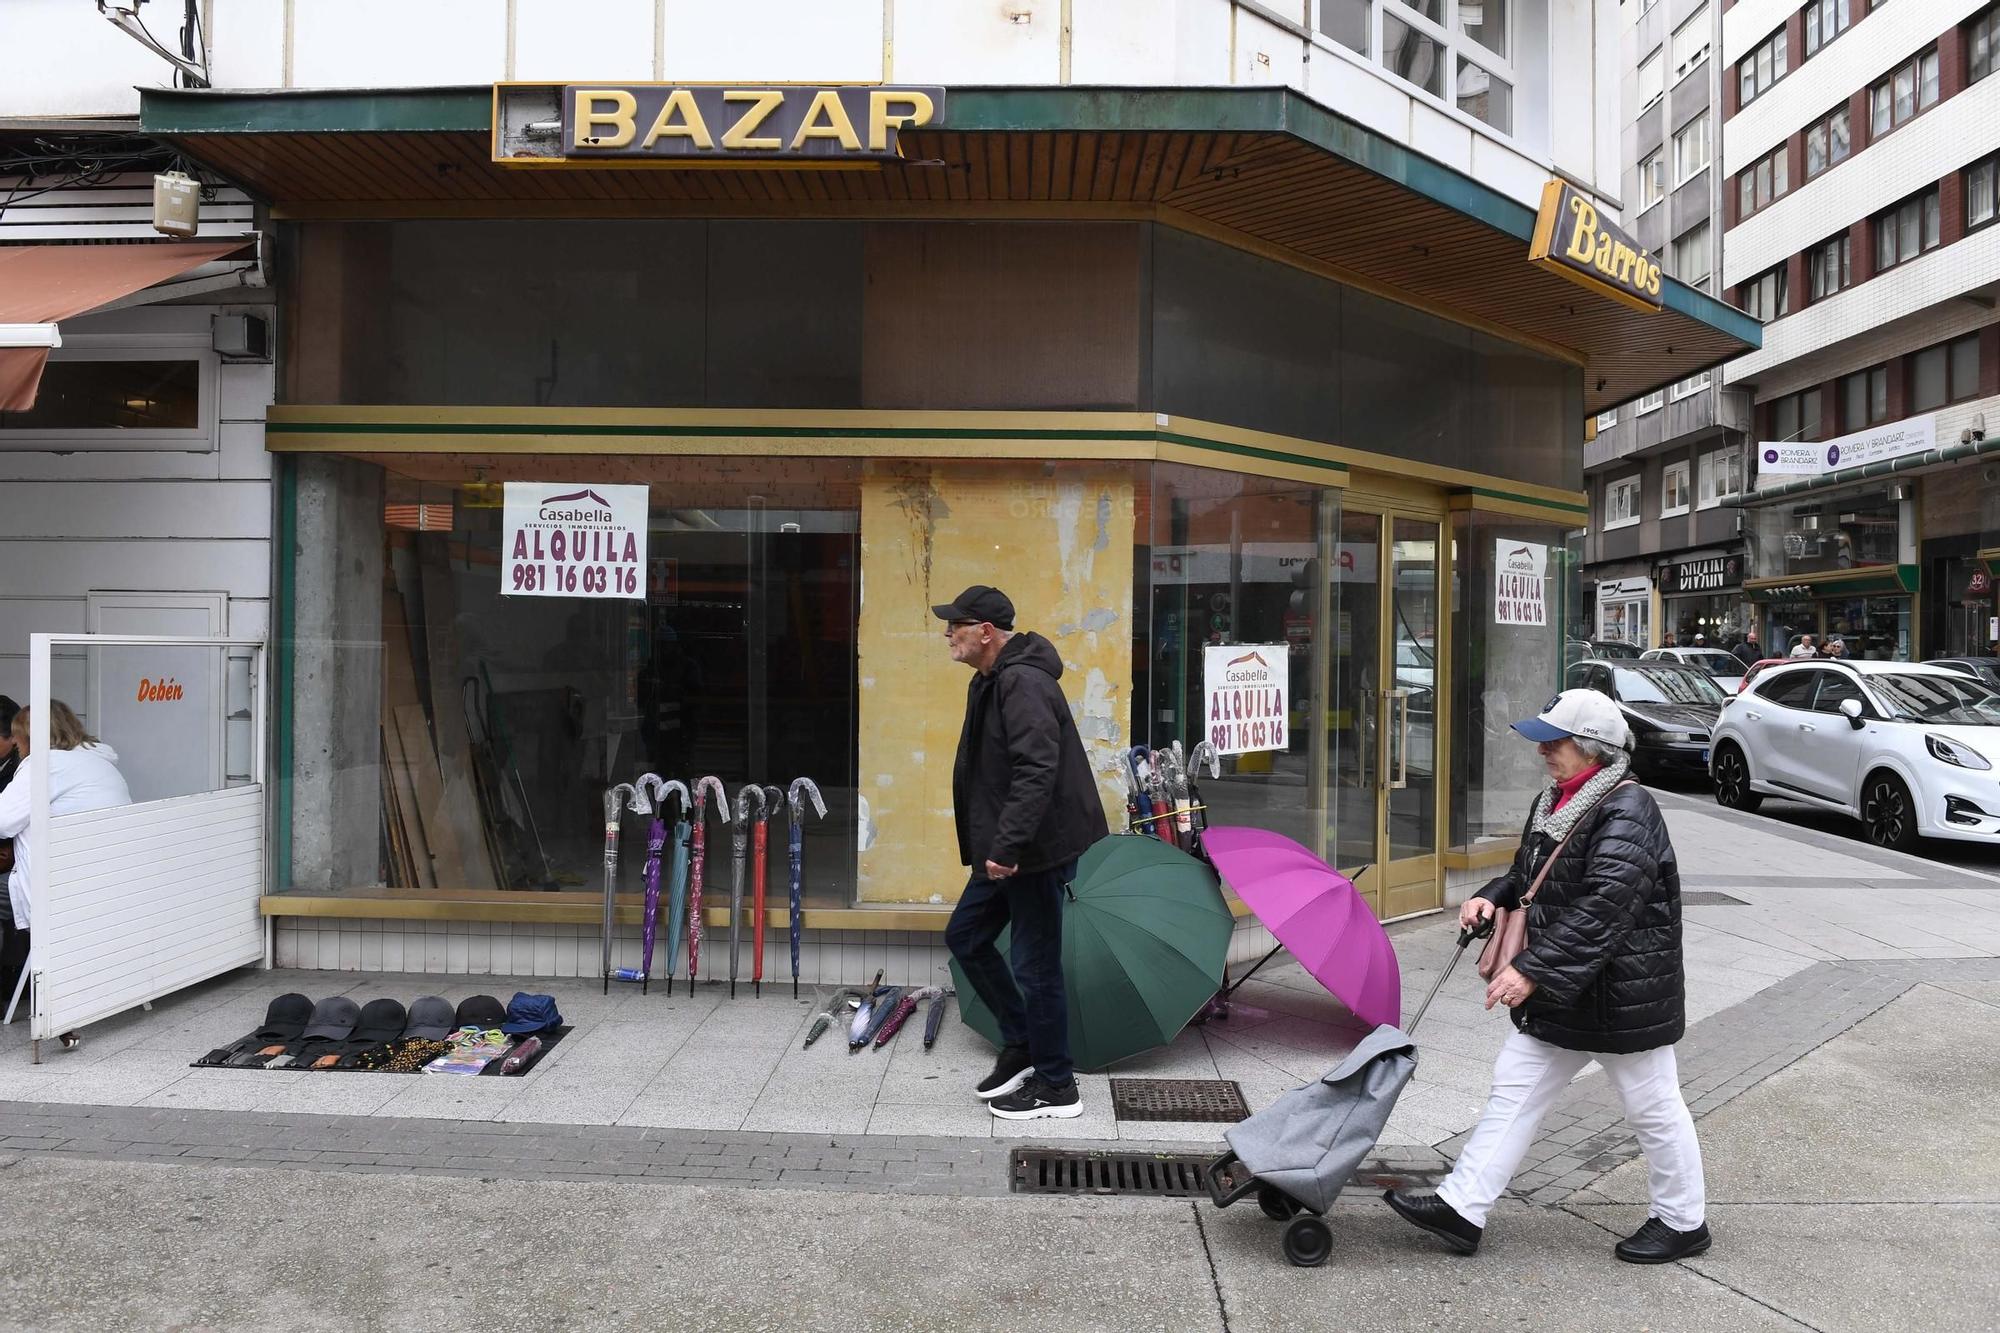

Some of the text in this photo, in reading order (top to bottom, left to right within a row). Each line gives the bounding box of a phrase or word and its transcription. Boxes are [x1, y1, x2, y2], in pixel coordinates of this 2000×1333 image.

[1566, 196, 1661, 296] Barrós
[1840, 442, 1865, 455] ROMERA
[539, 508, 613, 523] Casabella
[512, 529, 638, 563] ALQUILA
[512, 564, 637, 594] 981 16 03 16
[1499, 574, 1541, 600] ALQUILA
[1680, 558, 1724, 591] DIVAIN
[1498, 600, 1511, 621] 981
[1514, 601, 1522, 622] 16
[1534, 603, 1542, 623] 16
[1226, 669, 1268, 682] Casabella
[138, 677, 184, 702] Debén
[1211, 689, 1282, 721] ALQUILA
[1211, 720, 1283, 751] 981 16 03 16
[1583, 727, 1599, 735] 1906
